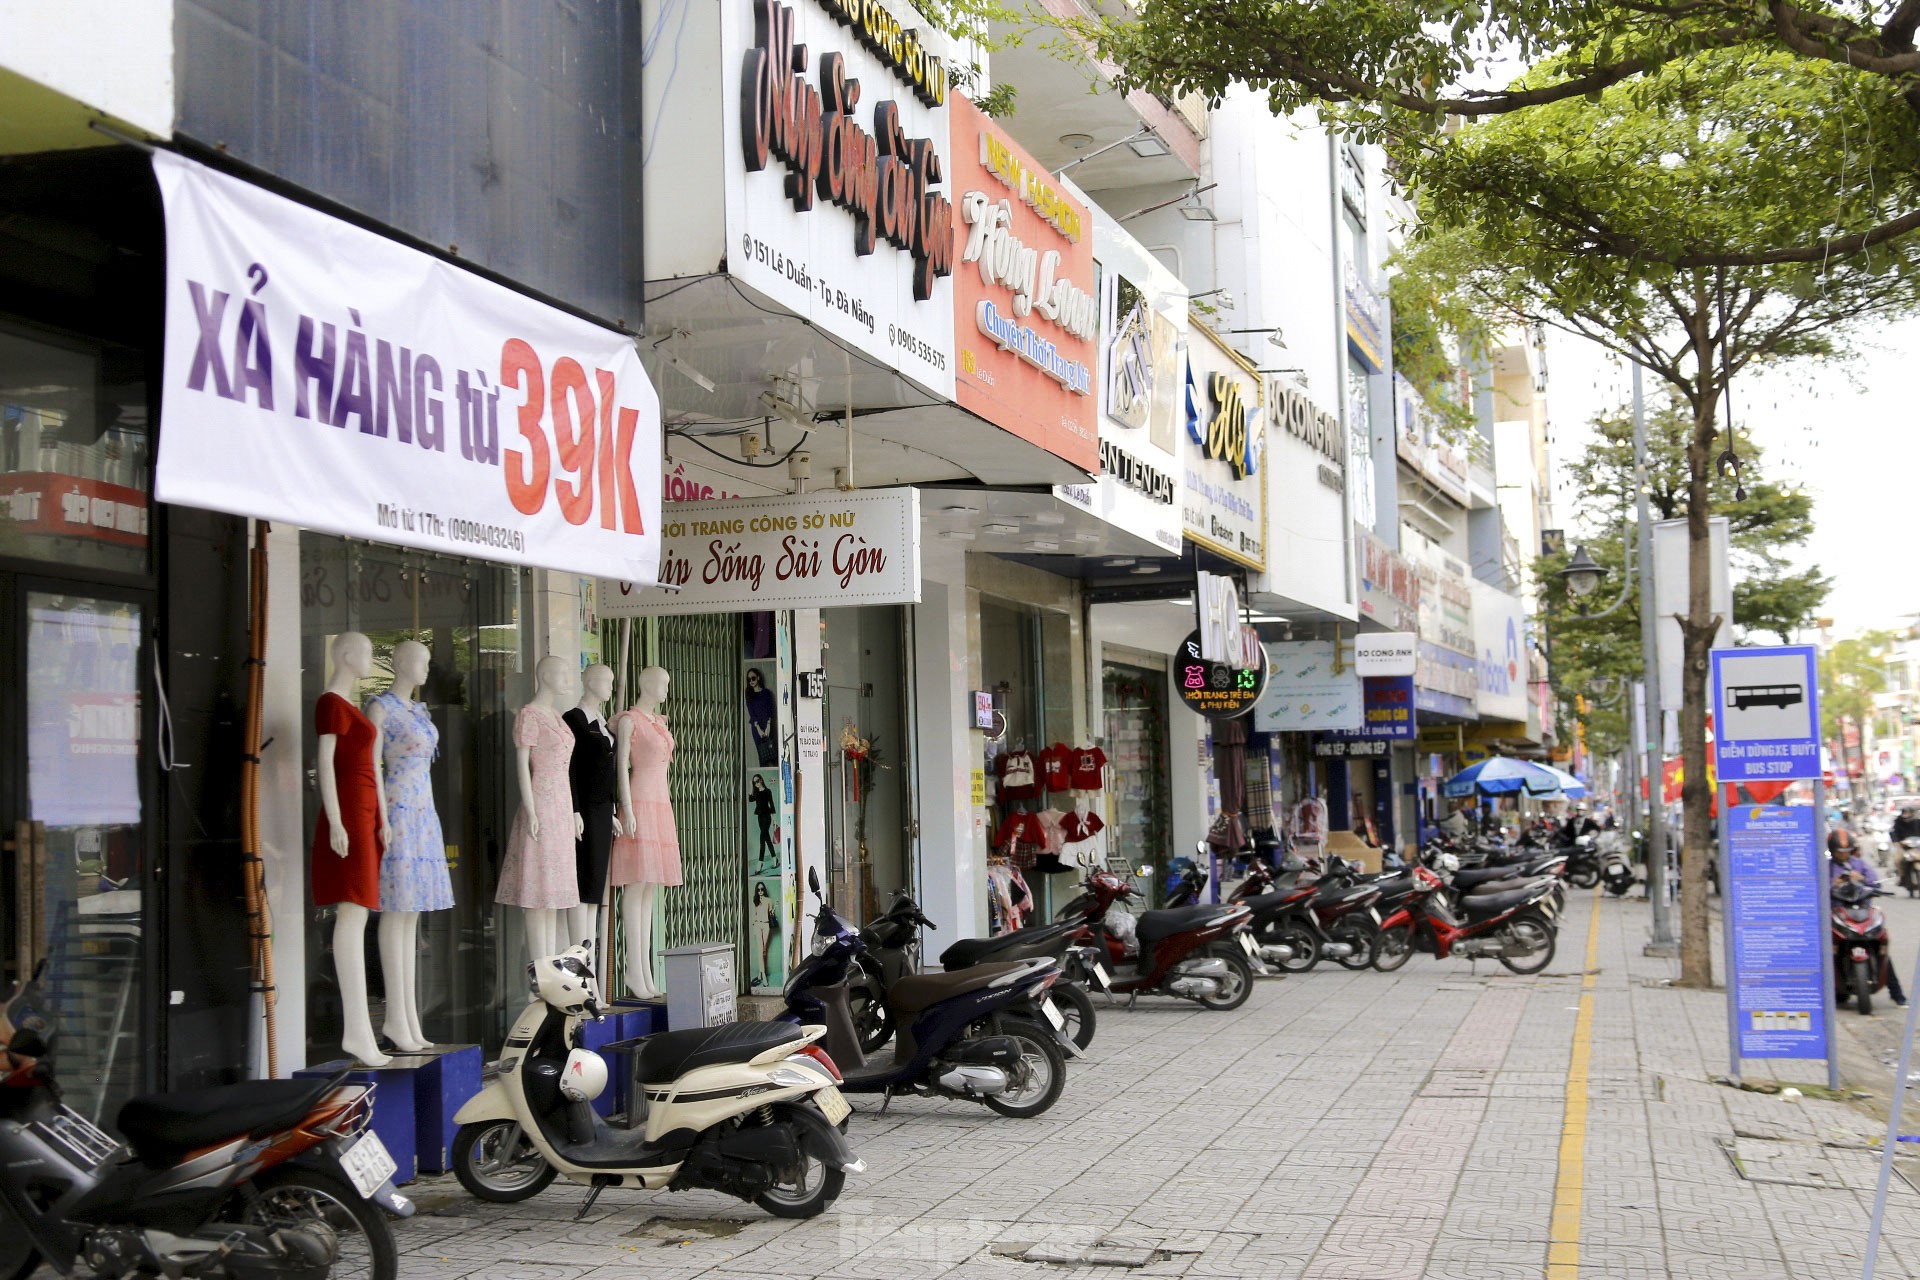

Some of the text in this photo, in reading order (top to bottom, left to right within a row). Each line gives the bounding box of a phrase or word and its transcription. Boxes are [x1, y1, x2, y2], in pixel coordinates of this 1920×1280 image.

[980, 132, 1022, 190] NEW
[753, 239, 770, 266] 151
[771, 249, 784, 275] Lê
[786, 263, 812, 292] Duẩn
[819, 279, 835, 307] Tp.
[836, 289, 849, 315] Đà
[851, 297, 875, 335] Nẵng
[186, 262, 275, 412] XẢ
[294, 306, 445, 453] HÀNG
[455, 368, 500, 467] từ
[897, 328, 946, 371] 0905 535 575
[985, 301, 1024, 351] Chuyên
[1025, 327, 1049, 367] Thời
[1049, 343, 1076, 390] Trang
[377, 502, 398, 529] Mở
[418, 511, 444, 538] 17h:
[691, 519, 745, 536] TRANG
[750, 515, 797, 533] CÔNG
[802, 510, 826, 530] SỞ
[830, 510, 856, 528] NỮ
[702, 539, 766, 592] Sống
[775, 534, 823, 581] Sài
[832, 533, 888, 590] Gòn
[1357, 649, 1370, 657] BO
[1371, 649, 1394, 658] CONG
[1721, 741, 1745, 758] ĐIỂM
[1775, 744, 1788, 757] XE
[1791, 740, 1817, 757] BUÝT
[1744, 761, 1794, 775] BUS STOP
